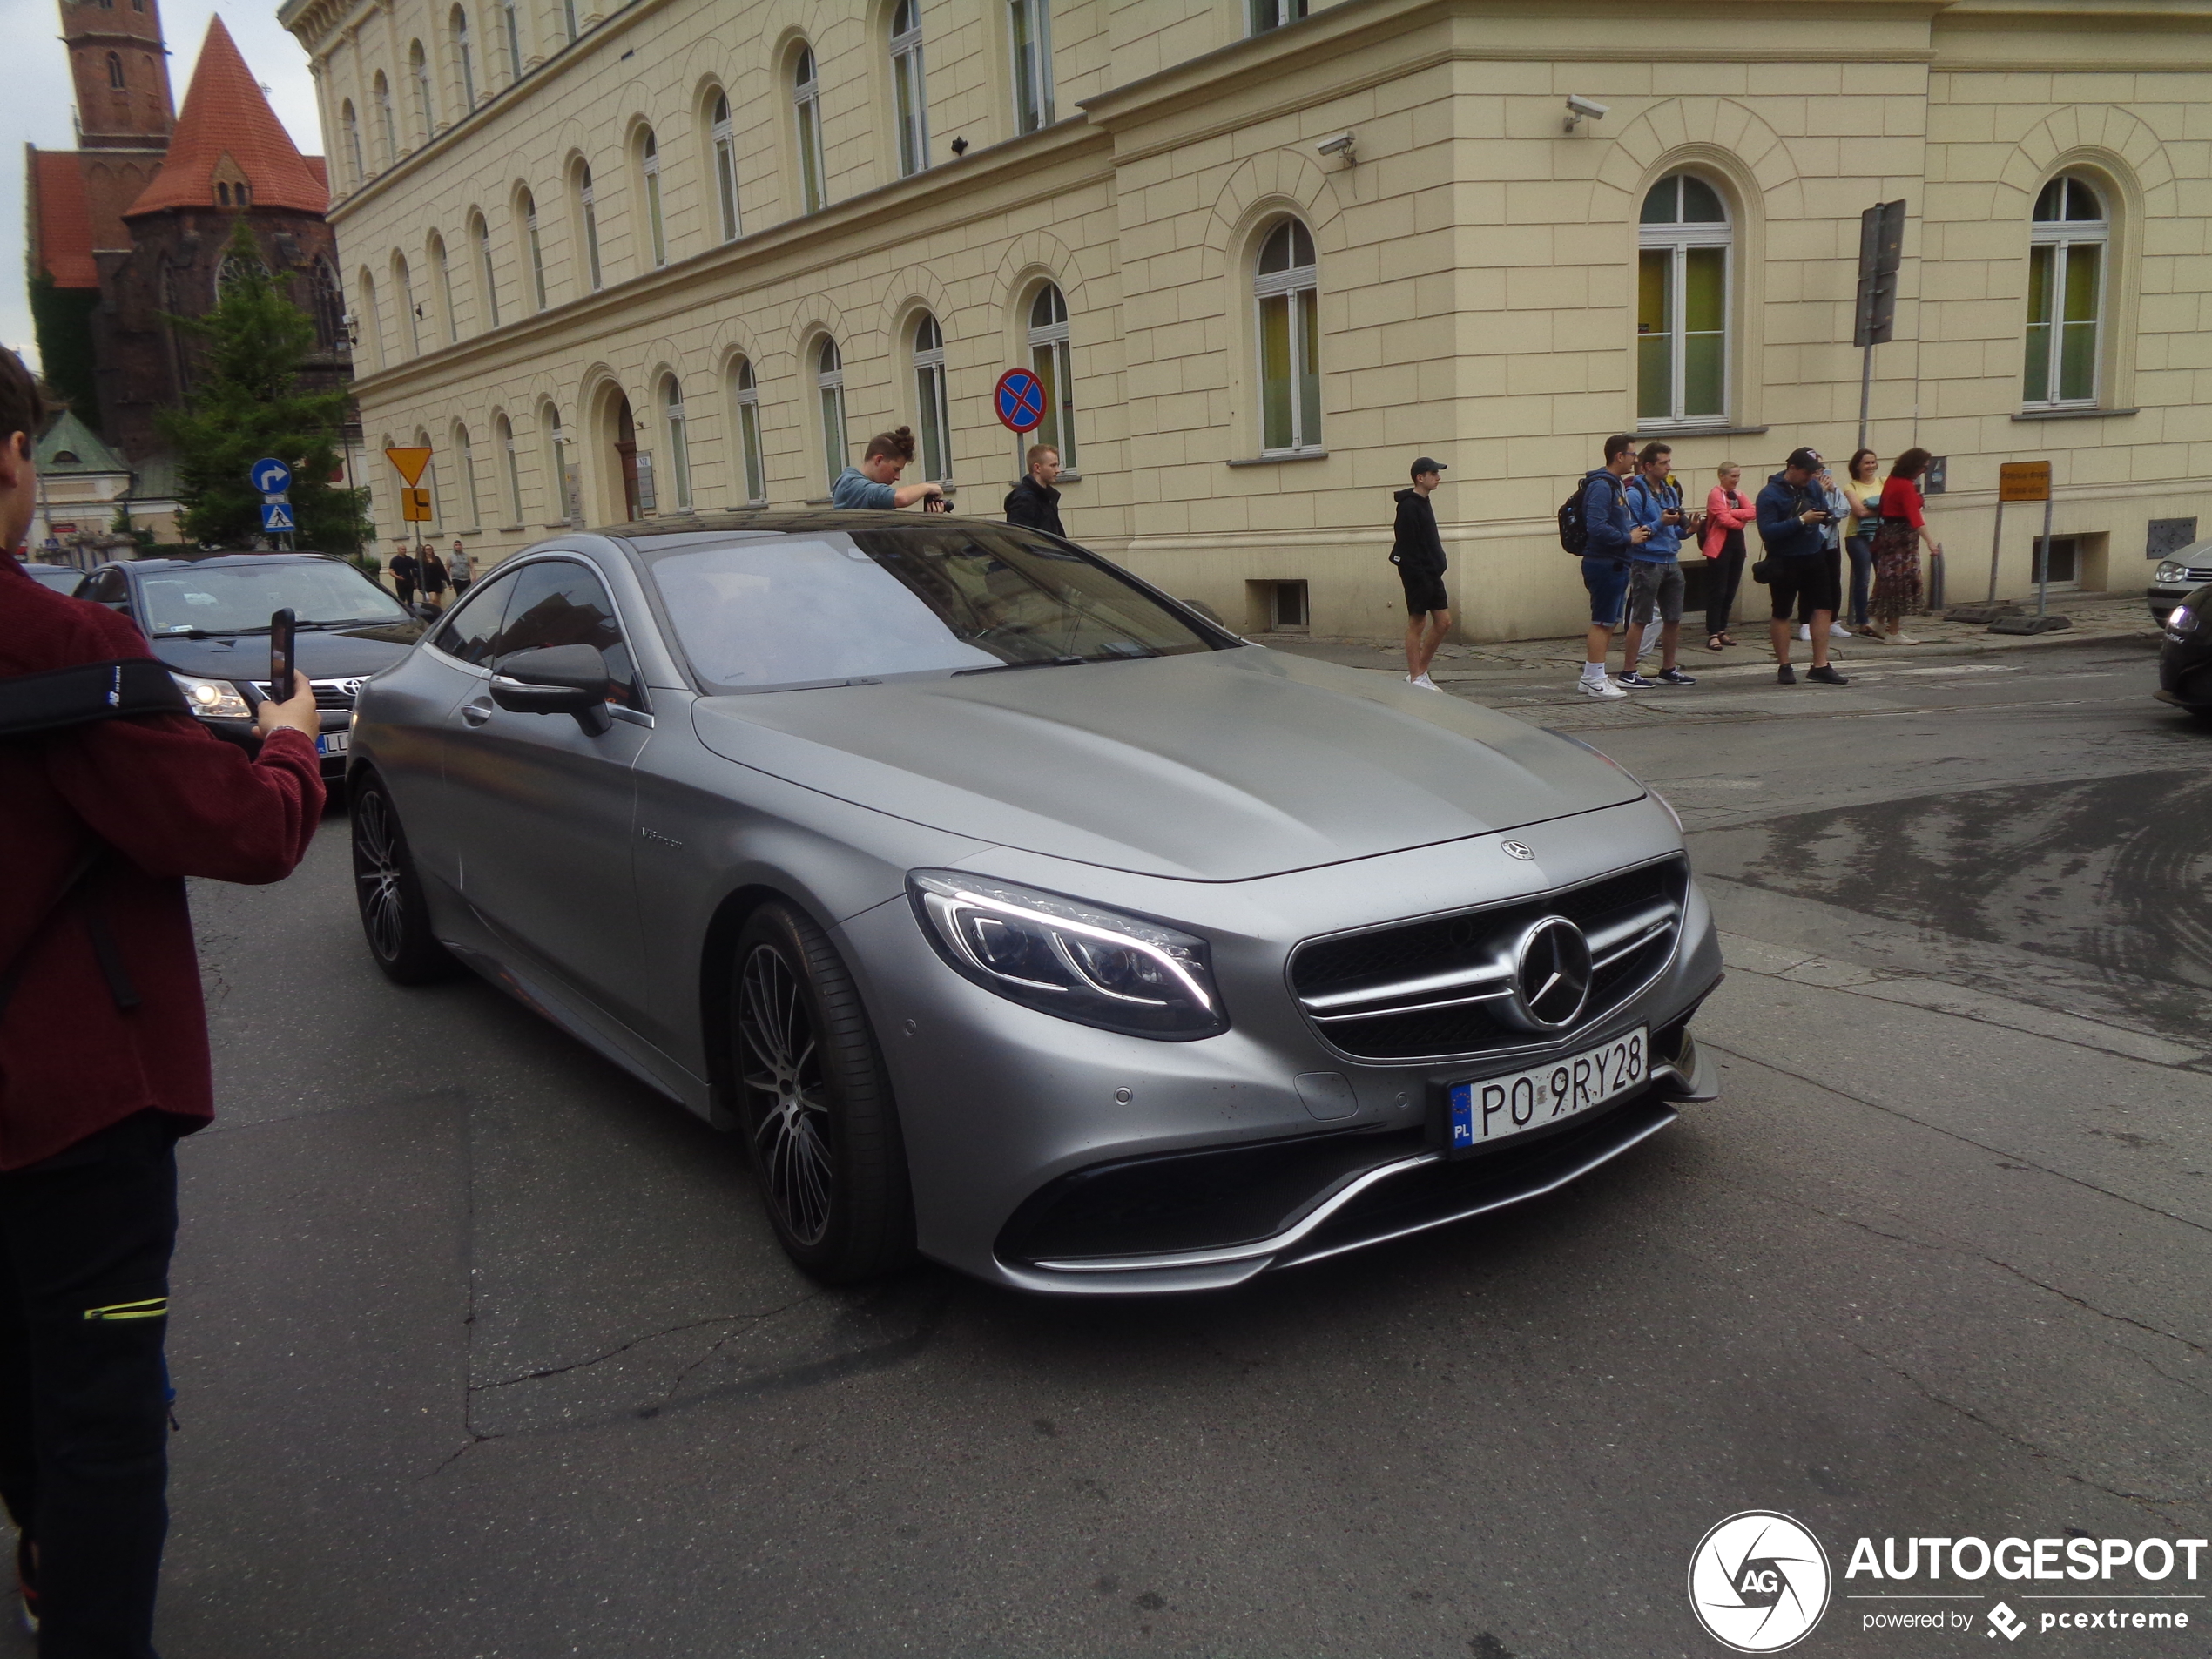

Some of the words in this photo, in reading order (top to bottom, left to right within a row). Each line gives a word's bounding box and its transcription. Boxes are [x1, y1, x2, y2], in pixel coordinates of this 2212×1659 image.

[1482, 1076, 1534, 1136] PO
[1550, 1035, 1641, 1116] 9RY28
[1454, 1124, 1470, 1139] PL
